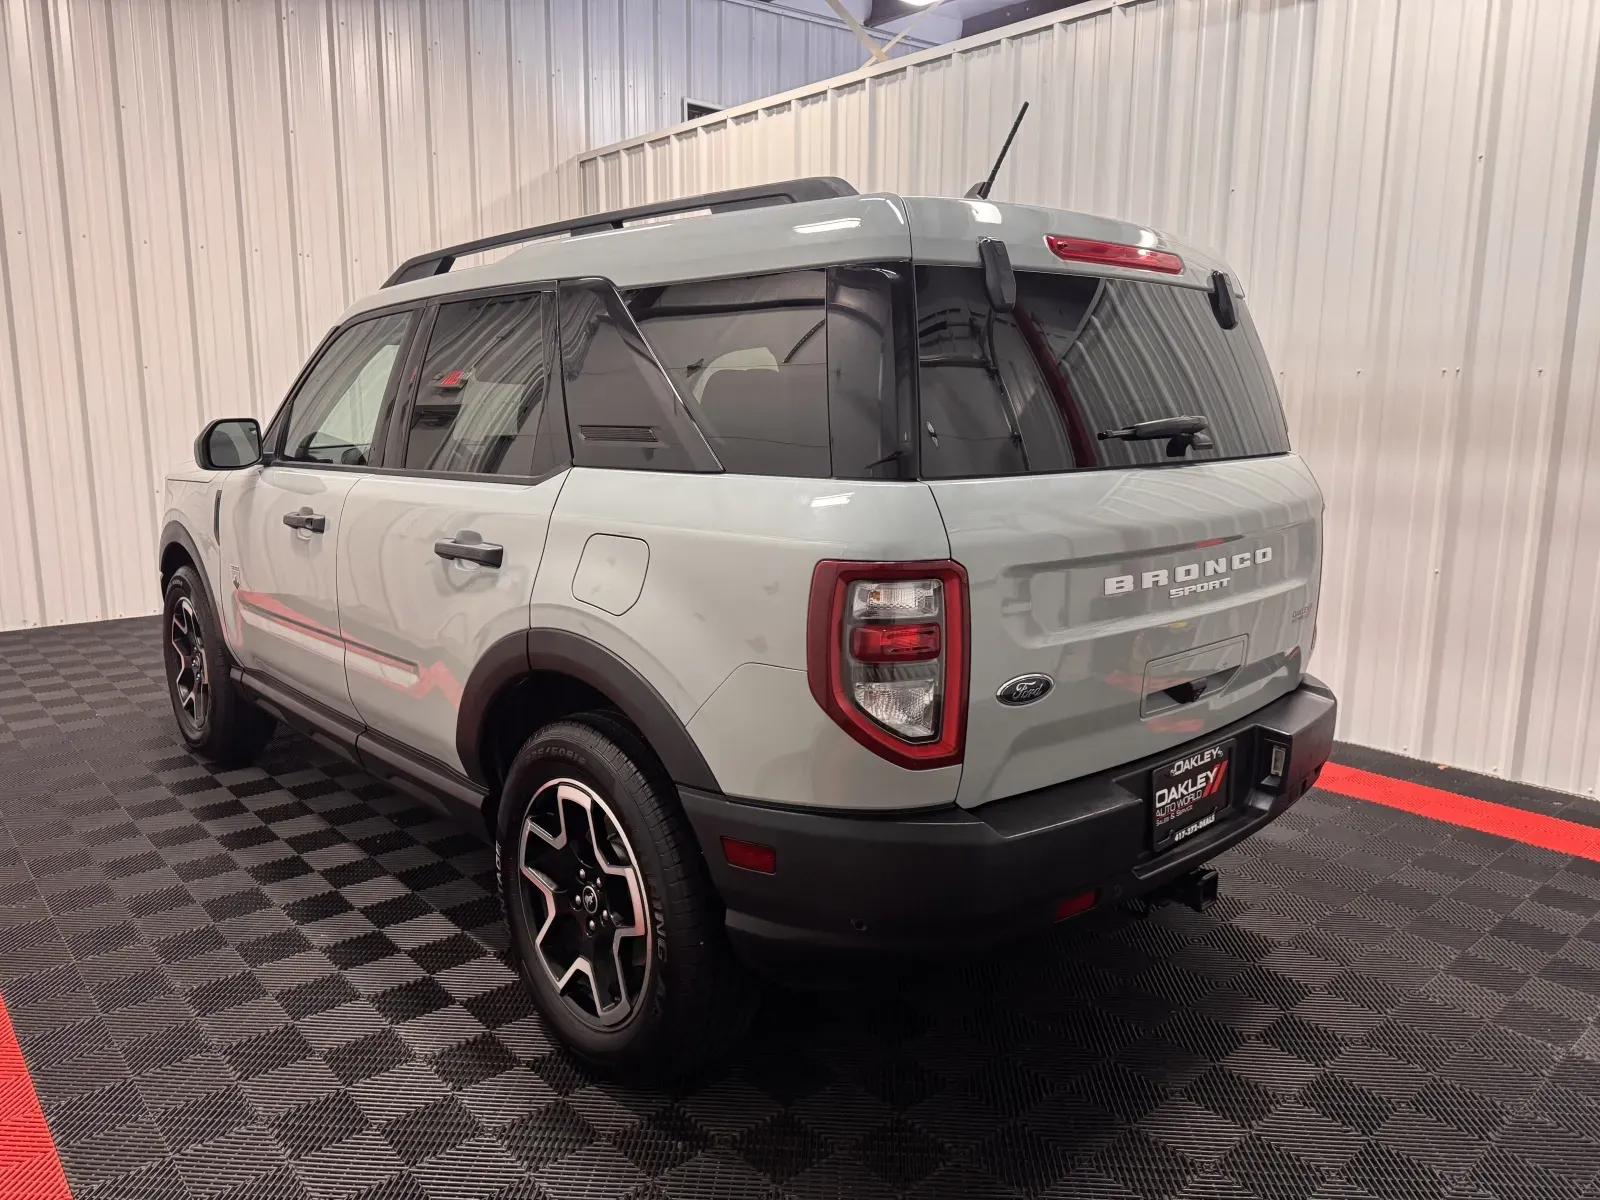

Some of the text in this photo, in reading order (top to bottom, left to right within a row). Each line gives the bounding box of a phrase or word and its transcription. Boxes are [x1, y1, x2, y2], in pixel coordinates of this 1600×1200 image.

[1104, 547, 1273, 596] BRONCO
[1169, 577, 1231, 599] SPORT
[1012, 681, 1043, 700] Ford
[1174, 746, 1220, 776] OAKLEY
[1155, 766, 1219, 808] OAKLEY
[1156, 790, 1203, 817] AUTO WORLD
